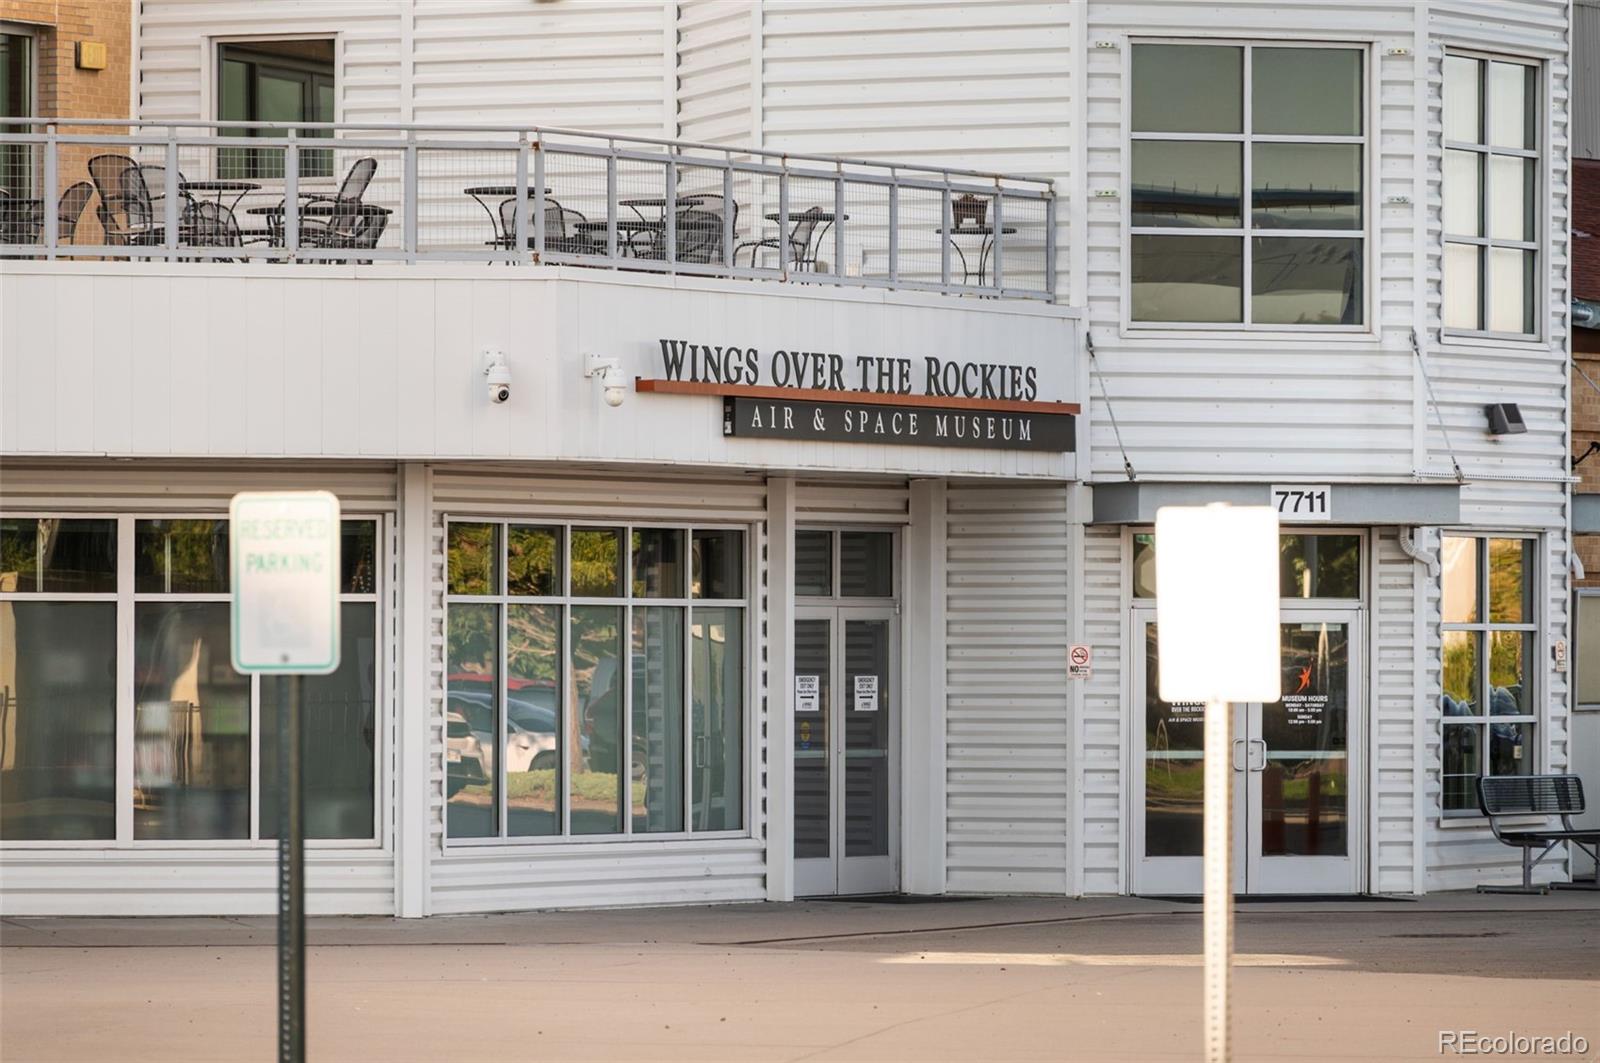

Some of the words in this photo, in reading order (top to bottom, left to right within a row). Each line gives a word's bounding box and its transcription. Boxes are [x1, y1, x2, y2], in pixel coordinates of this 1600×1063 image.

[659, 339, 759, 385] WINGS
[771, 350, 846, 391] OVER
[857, 356, 912, 395] THE
[924, 356, 1038, 401] ROCKIES
[751, 405, 795, 430] AIR
[813, 407, 826, 431] &
[844, 409, 919, 435] SPACE
[935, 414, 1032, 441] MUSEUM
[1275, 491, 1325, 513] 7711
[239, 518, 329, 540] RESERVED
[246, 552, 322, 574] PARKING
